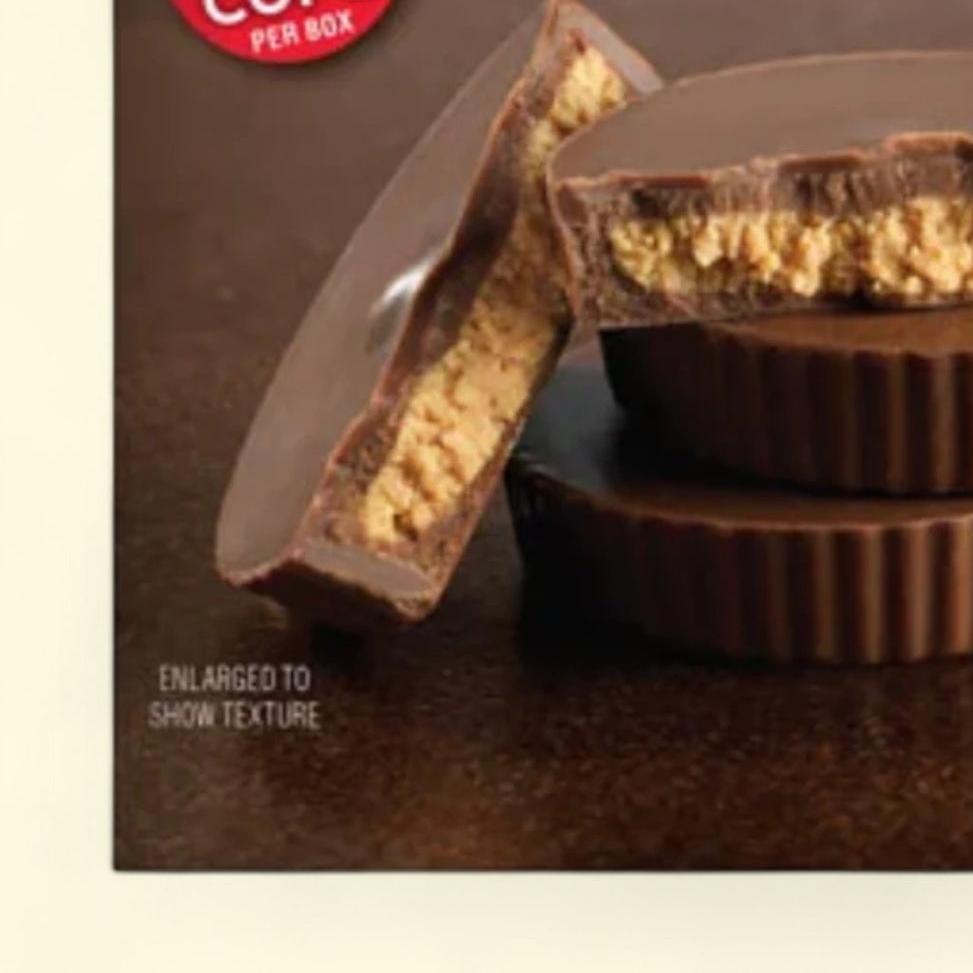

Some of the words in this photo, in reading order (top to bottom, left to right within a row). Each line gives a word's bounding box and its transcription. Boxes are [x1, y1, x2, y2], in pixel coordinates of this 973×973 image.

[250, 22, 300, 54] PER
[304, 9, 355, 42] BOX
[159, 664, 277, 692] ENLARGED
[282, 664, 312, 692] TO
[149, 701, 216, 728] SHOW
[223, 701, 321, 728] TEXTURE
